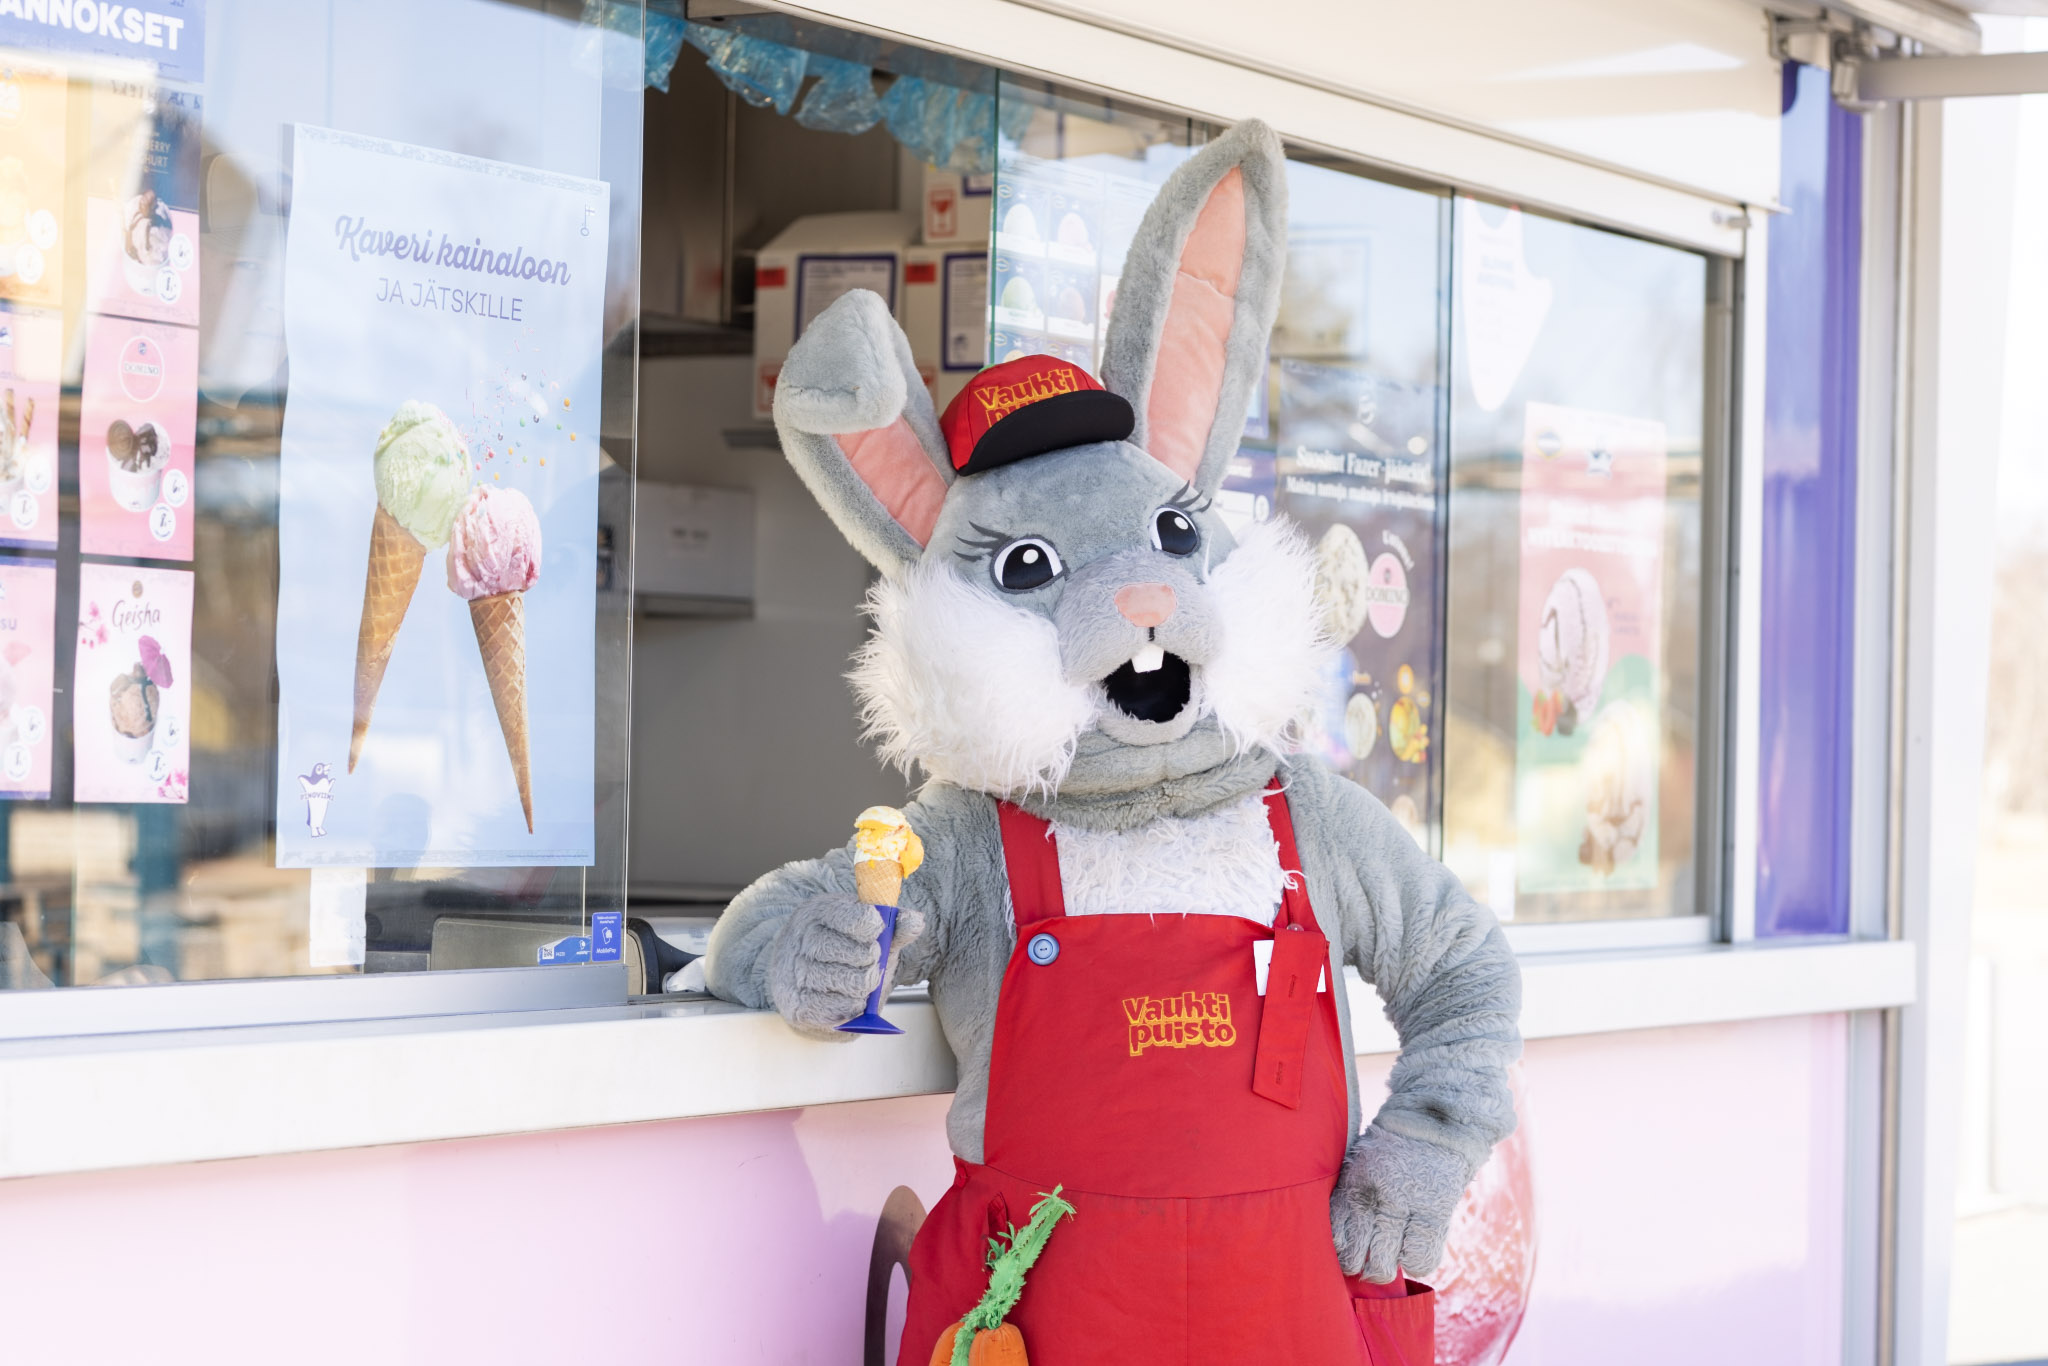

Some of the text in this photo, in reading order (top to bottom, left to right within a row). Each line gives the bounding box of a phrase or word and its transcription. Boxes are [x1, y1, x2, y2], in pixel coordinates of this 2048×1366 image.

[335, 214, 571, 286] Kaveri kainaloon
[376, 277, 523, 322] JA JÄTSKILLE
[974, 368, 1079, 410] Vauhti
[112, 599, 161, 632] Geisha
[1122, 991, 1232, 1026] Vauhti
[1128, 1018, 1237, 1057] puisto
